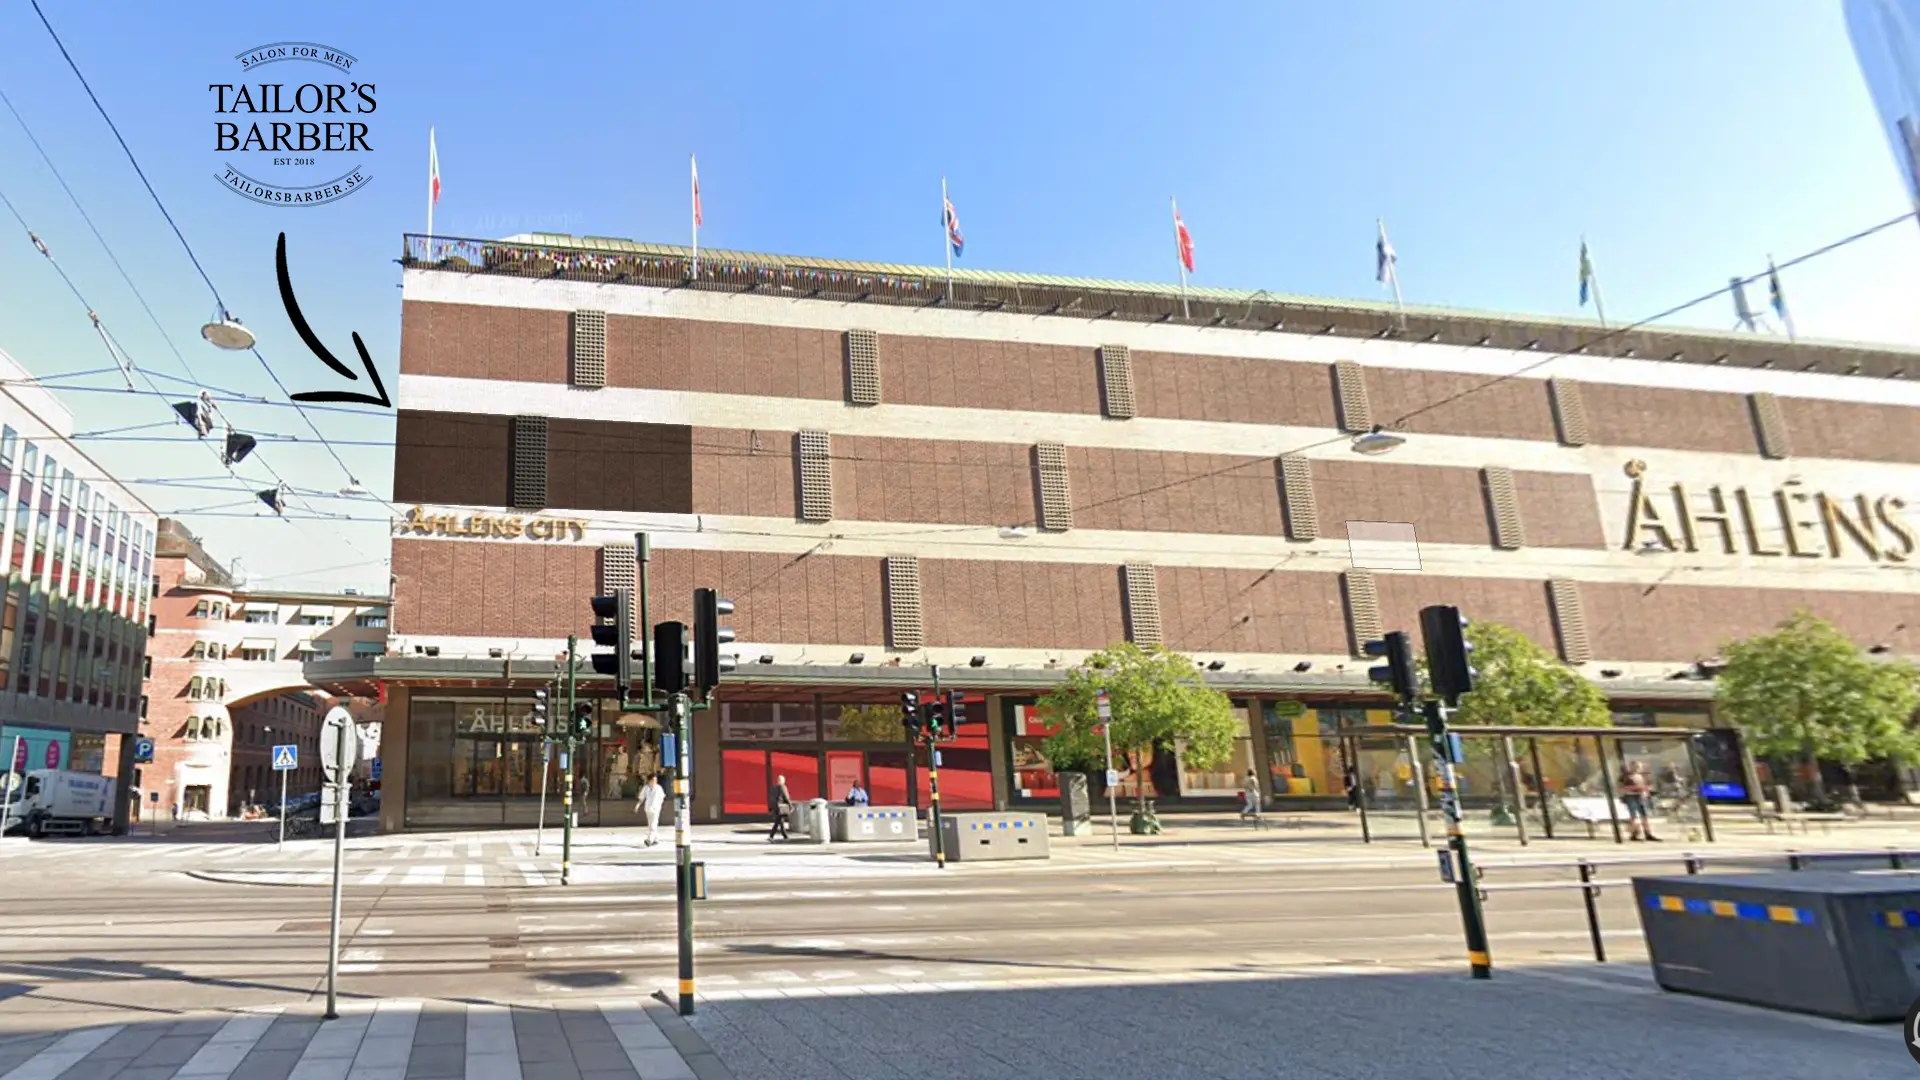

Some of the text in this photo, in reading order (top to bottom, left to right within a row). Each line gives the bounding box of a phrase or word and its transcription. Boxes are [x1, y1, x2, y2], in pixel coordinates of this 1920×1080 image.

[1622, 458, 1914, 563] ÅHLÉNS
[532, 516, 590, 541] CITY
[140, 743, 151, 756] P
